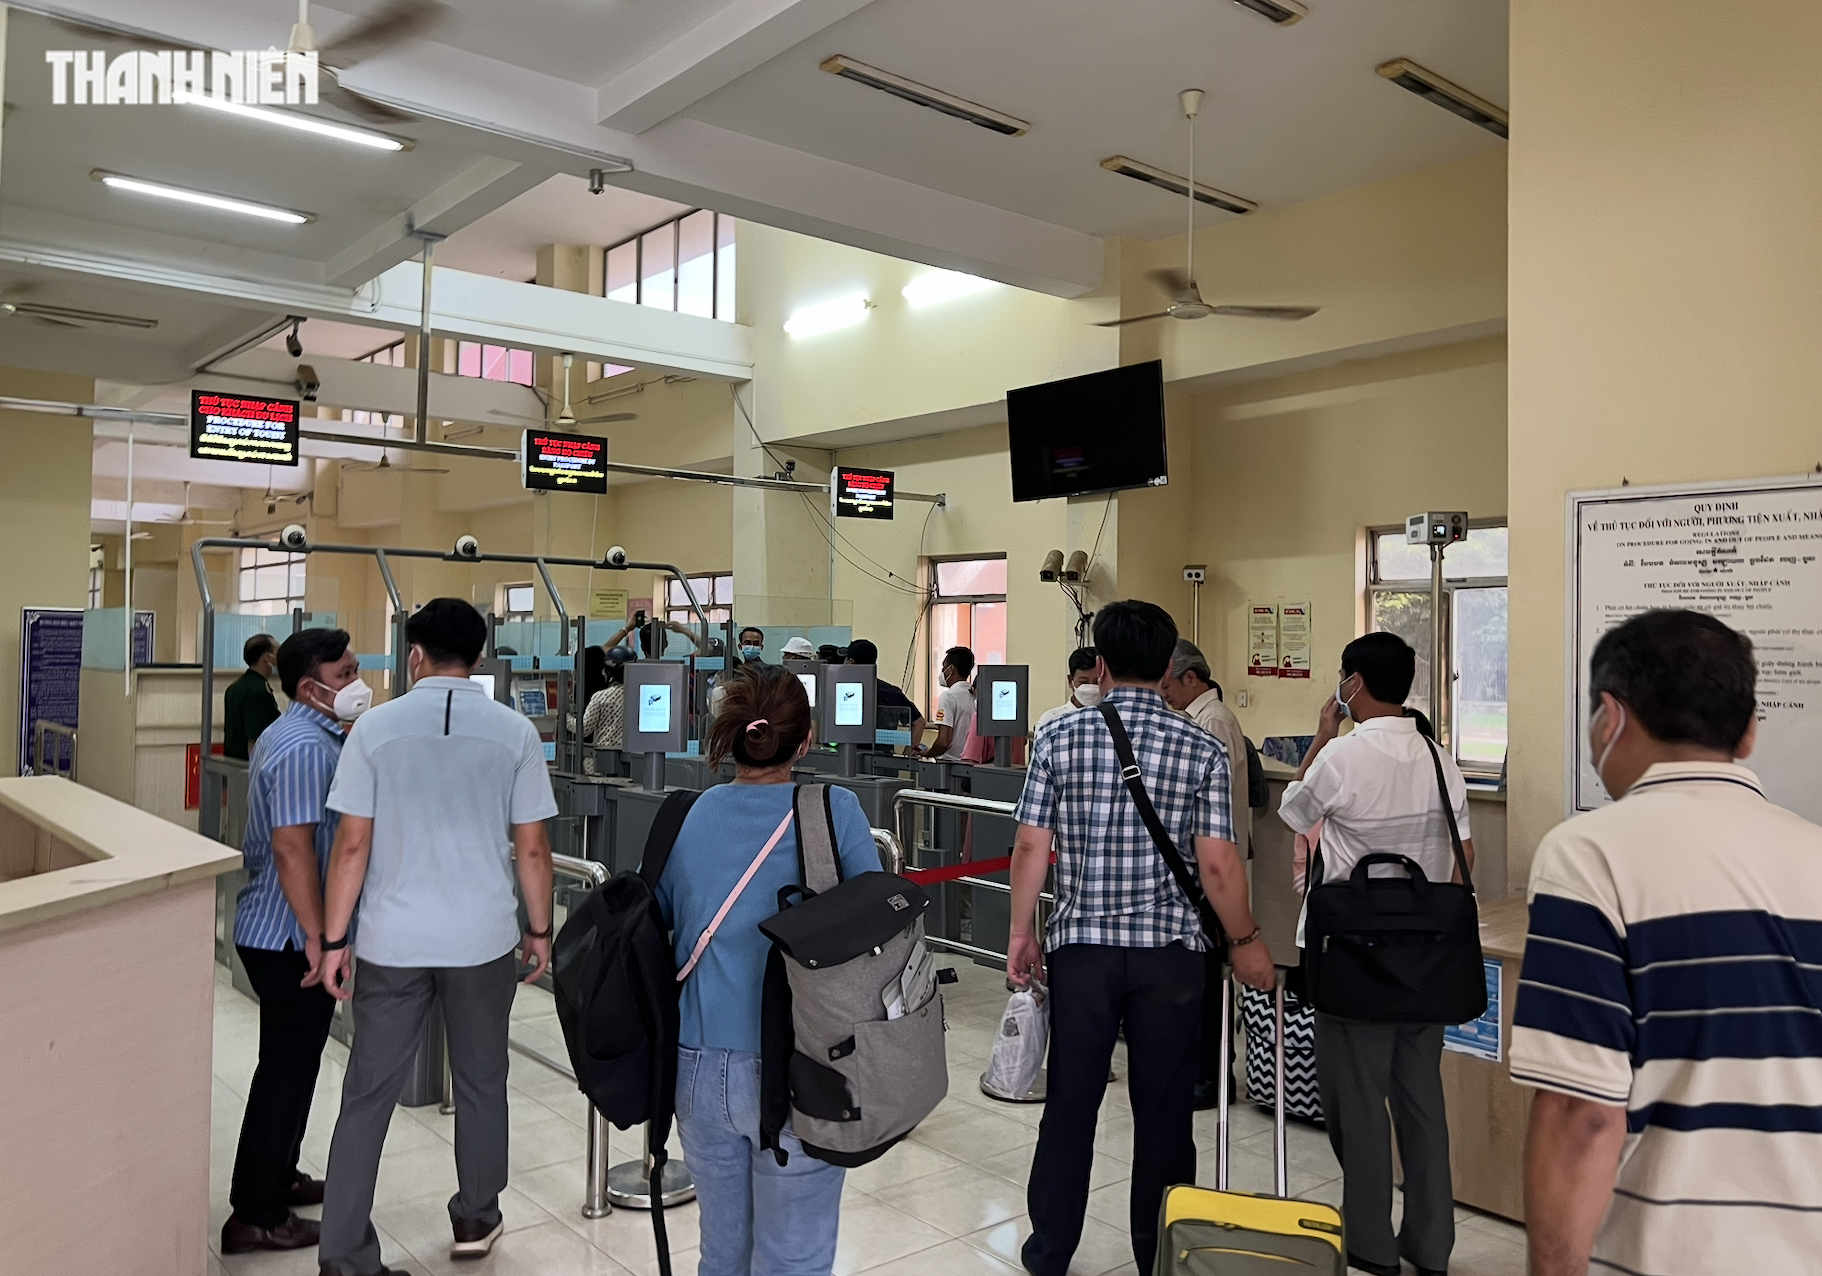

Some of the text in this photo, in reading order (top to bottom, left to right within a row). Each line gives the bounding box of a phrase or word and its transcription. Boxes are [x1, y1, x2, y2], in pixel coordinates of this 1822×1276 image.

[1694, 502, 1739, 513] QUY ĐỊNH
[1620, 521, 1637, 532] TỤC
[1707, 515, 1744, 526] PHƯƠNG
